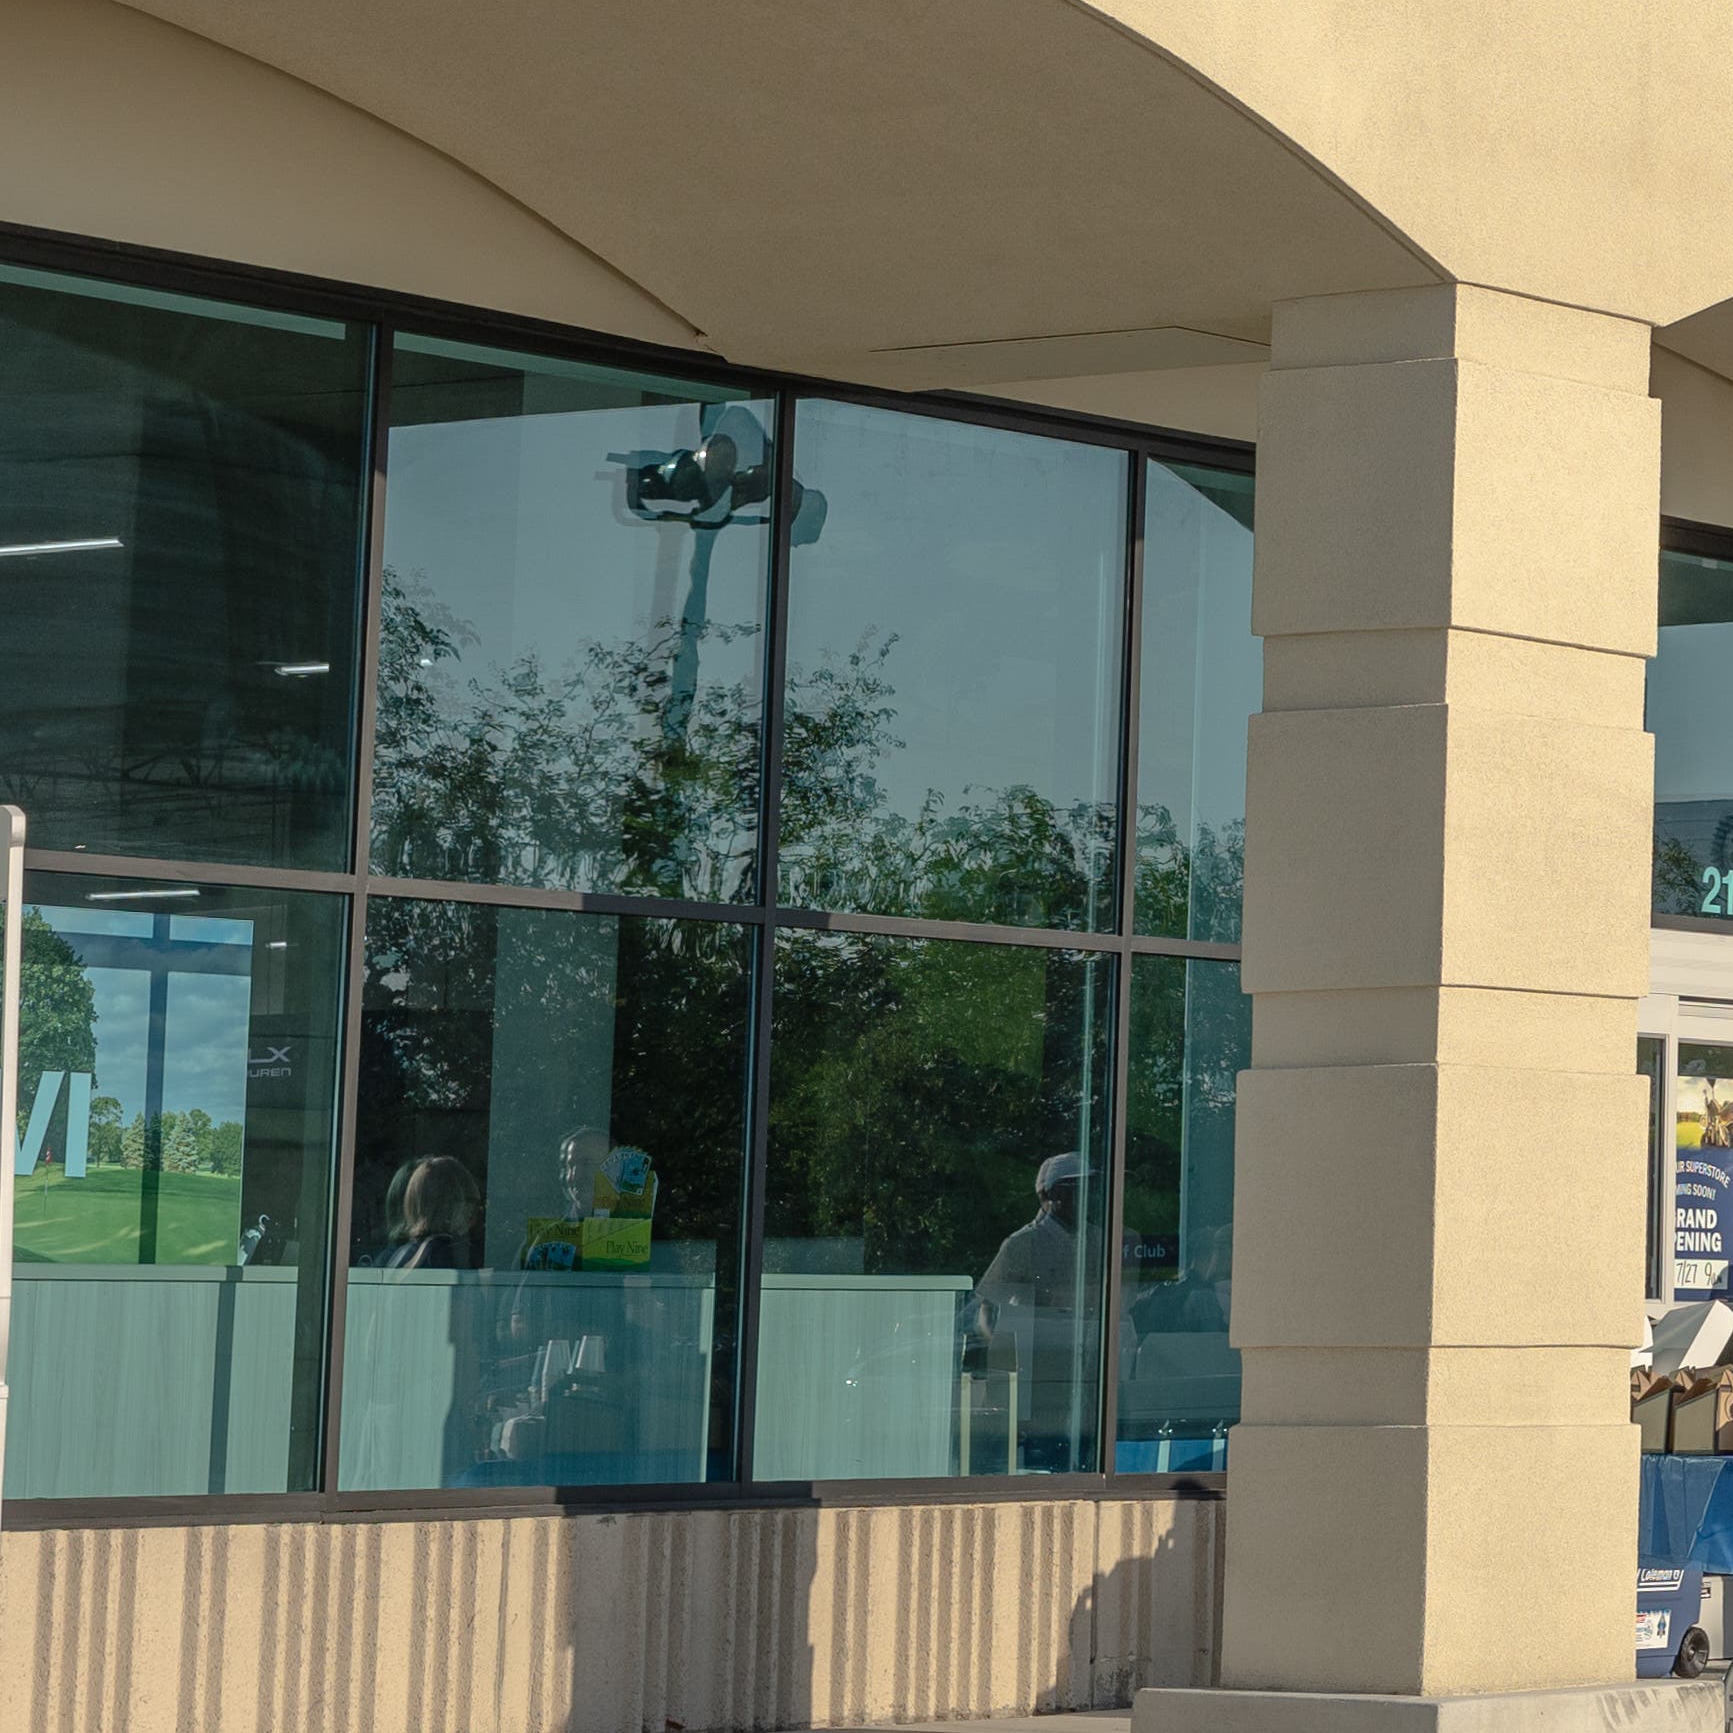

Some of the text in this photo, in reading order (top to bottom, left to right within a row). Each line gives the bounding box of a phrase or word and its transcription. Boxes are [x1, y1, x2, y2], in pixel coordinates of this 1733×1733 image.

[250, 1067, 291, 1078] UREN
[1686, 1161, 1731, 1188] SUPERSTORE
[1692, 1184, 1717, 1201] SOON!
[1676, 1208, 1718, 1229] RAND
[606, 1240, 649, 1258] Play Nine
[1134, 1244, 1166, 1258] Club
[1675, 1231, 1722, 1253] ENING
[1676, 1261, 1698, 1286] 7/27
[1641, 1569, 1673, 1582] Coleman
